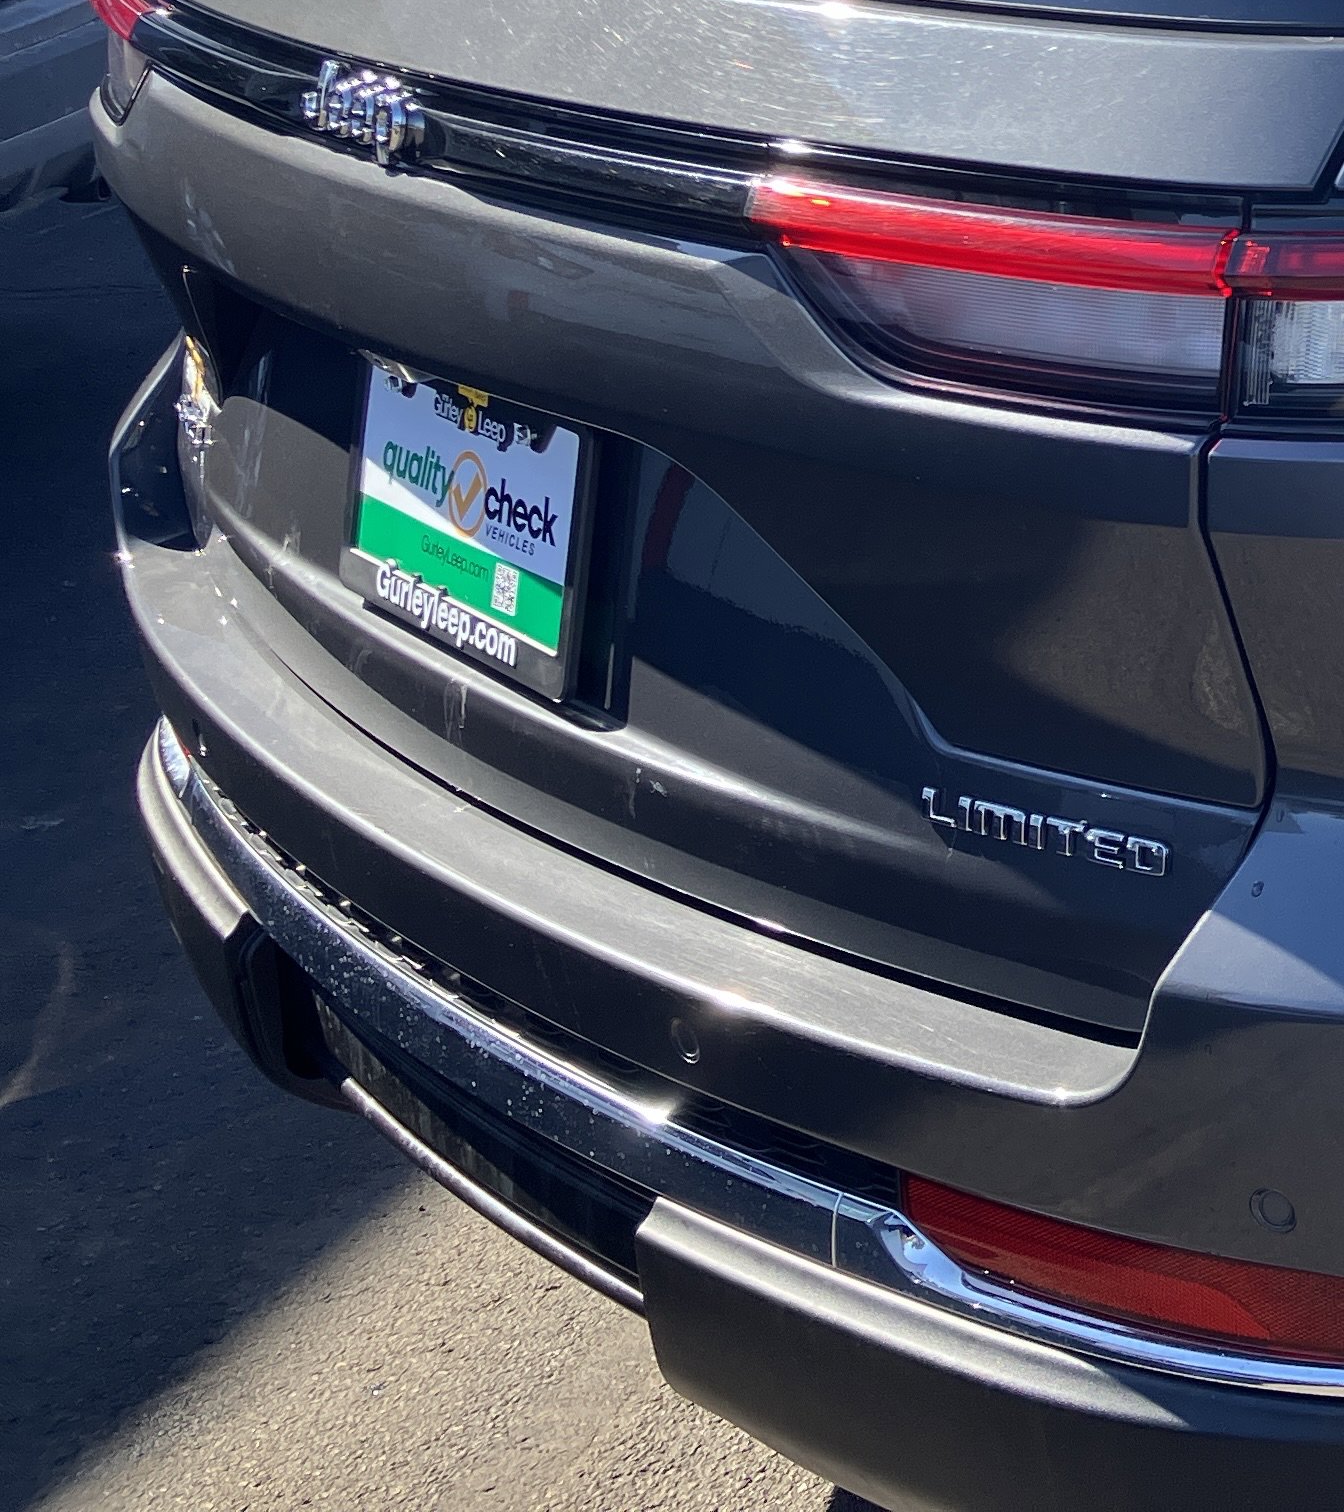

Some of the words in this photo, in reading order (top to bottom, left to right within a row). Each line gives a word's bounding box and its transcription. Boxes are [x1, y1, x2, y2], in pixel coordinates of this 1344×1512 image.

[302, 60, 425, 165] Jeep
[383, 440, 455, 508] quality
[485, 478, 558, 547] check
[485, 524, 535, 556] VEHICLES
[921, 786, 1171, 877] LIMITED
